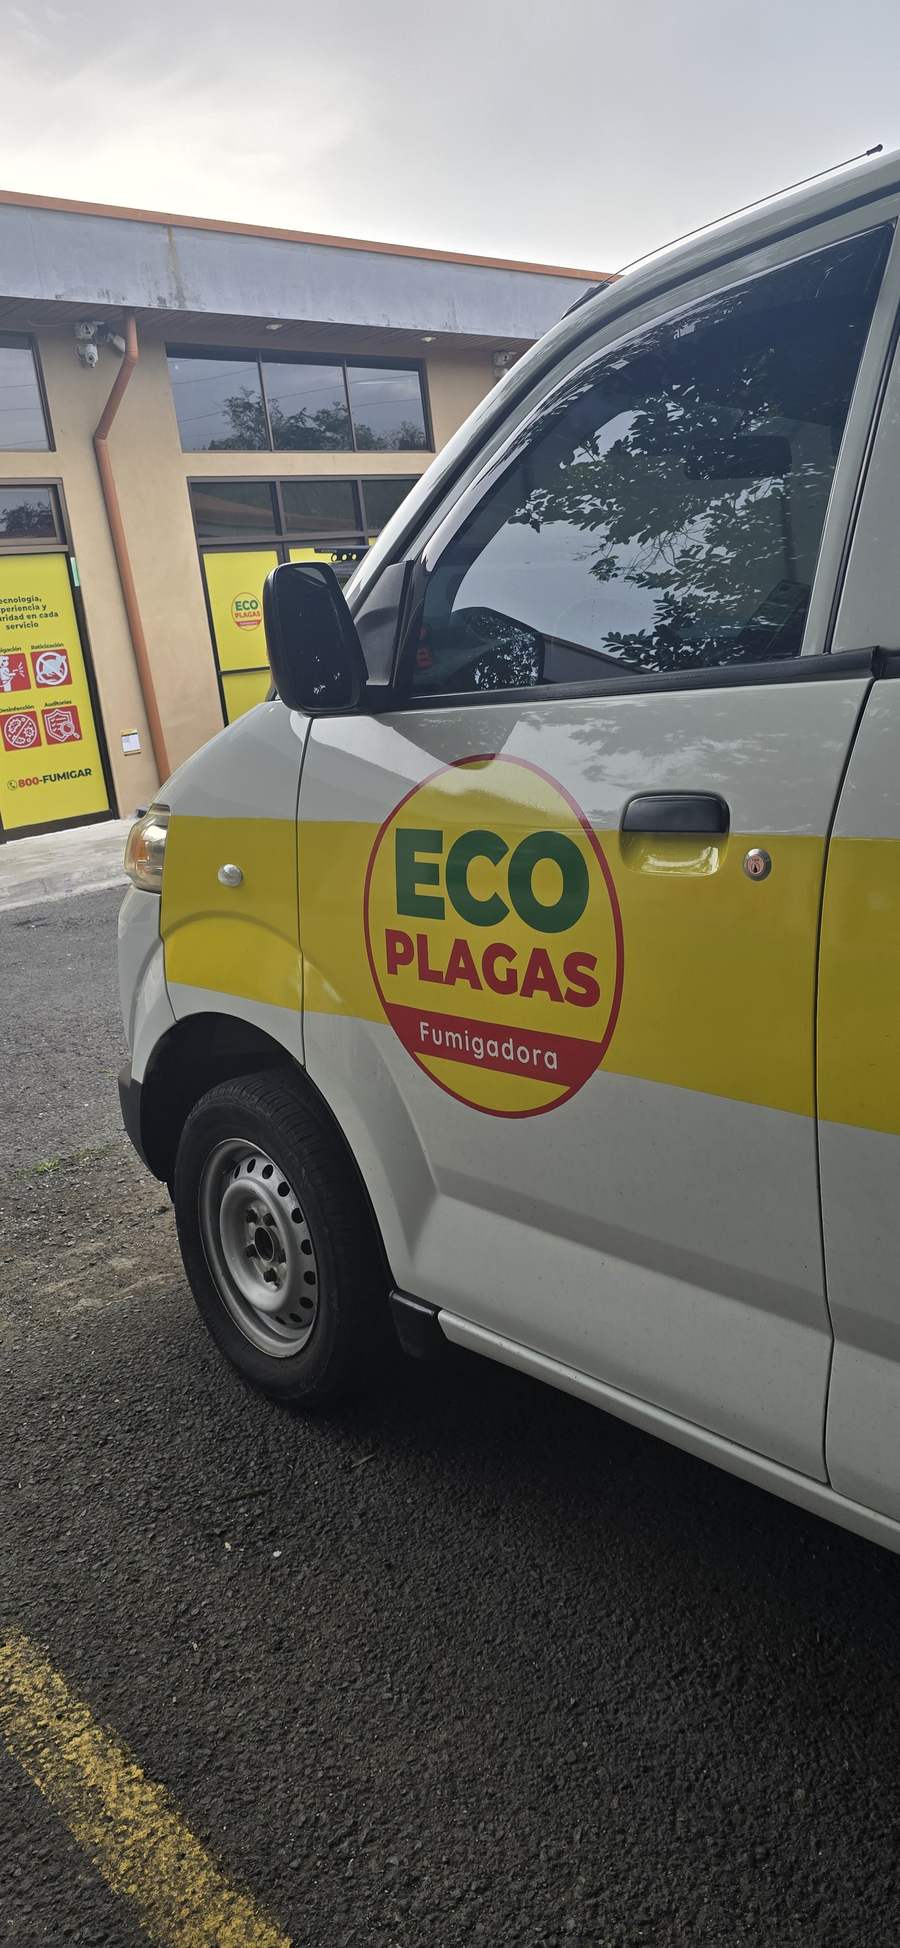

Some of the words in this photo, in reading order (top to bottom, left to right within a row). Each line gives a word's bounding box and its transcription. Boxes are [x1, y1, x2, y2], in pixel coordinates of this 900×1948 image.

[0, 604, 40, 614] periencia
[235, 600, 259, 611] ECO
[39, 611, 59, 619] cada
[6, 621, 39, 630] servicio
[17, 768, 92, 788] 800-FUMIGAR
[395, 828, 590, 933] ECO
[385, 928, 601, 1008] PLAGAS
[419, 1021, 558, 1070] Fumigadora
